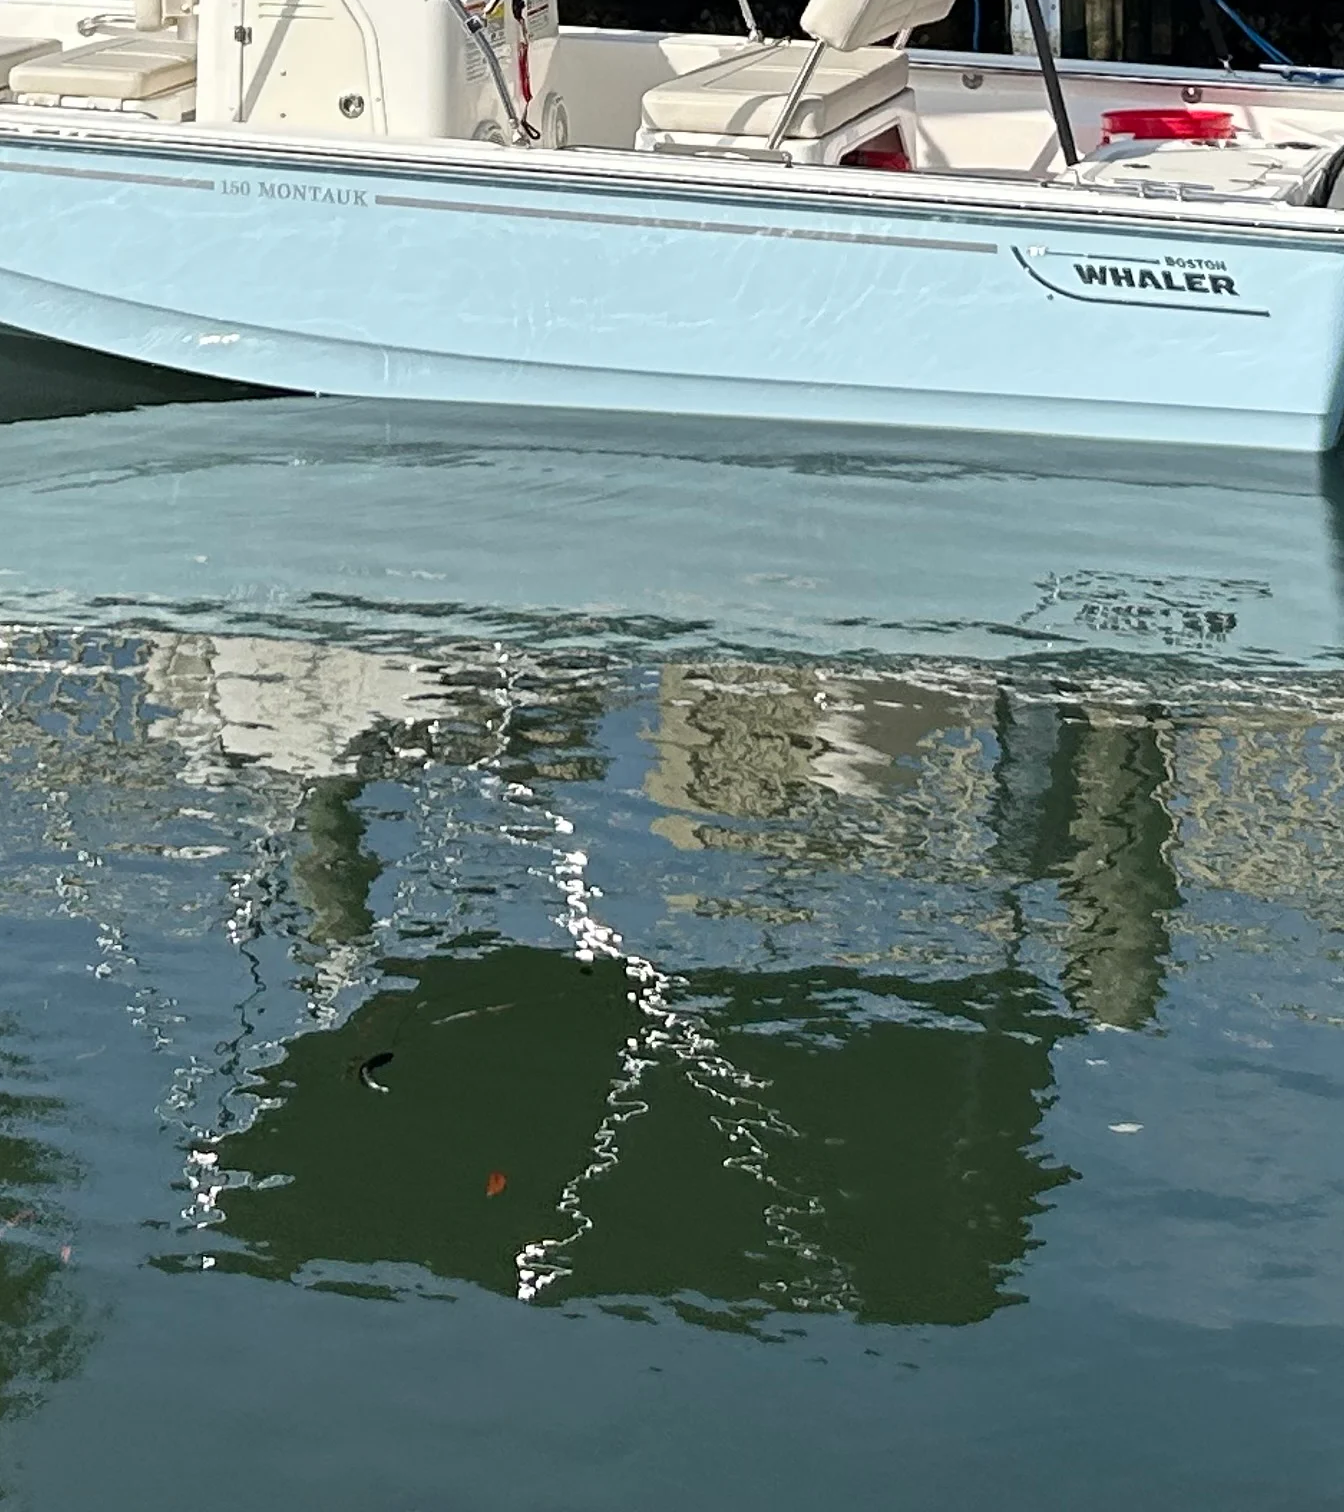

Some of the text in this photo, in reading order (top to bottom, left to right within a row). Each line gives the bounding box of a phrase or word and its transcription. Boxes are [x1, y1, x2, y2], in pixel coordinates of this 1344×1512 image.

[220, 179, 369, 208] 150 MONTAUK
[1164, 255, 1228, 271] BOSTON
[1072, 263, 1241, 297] WHALER
